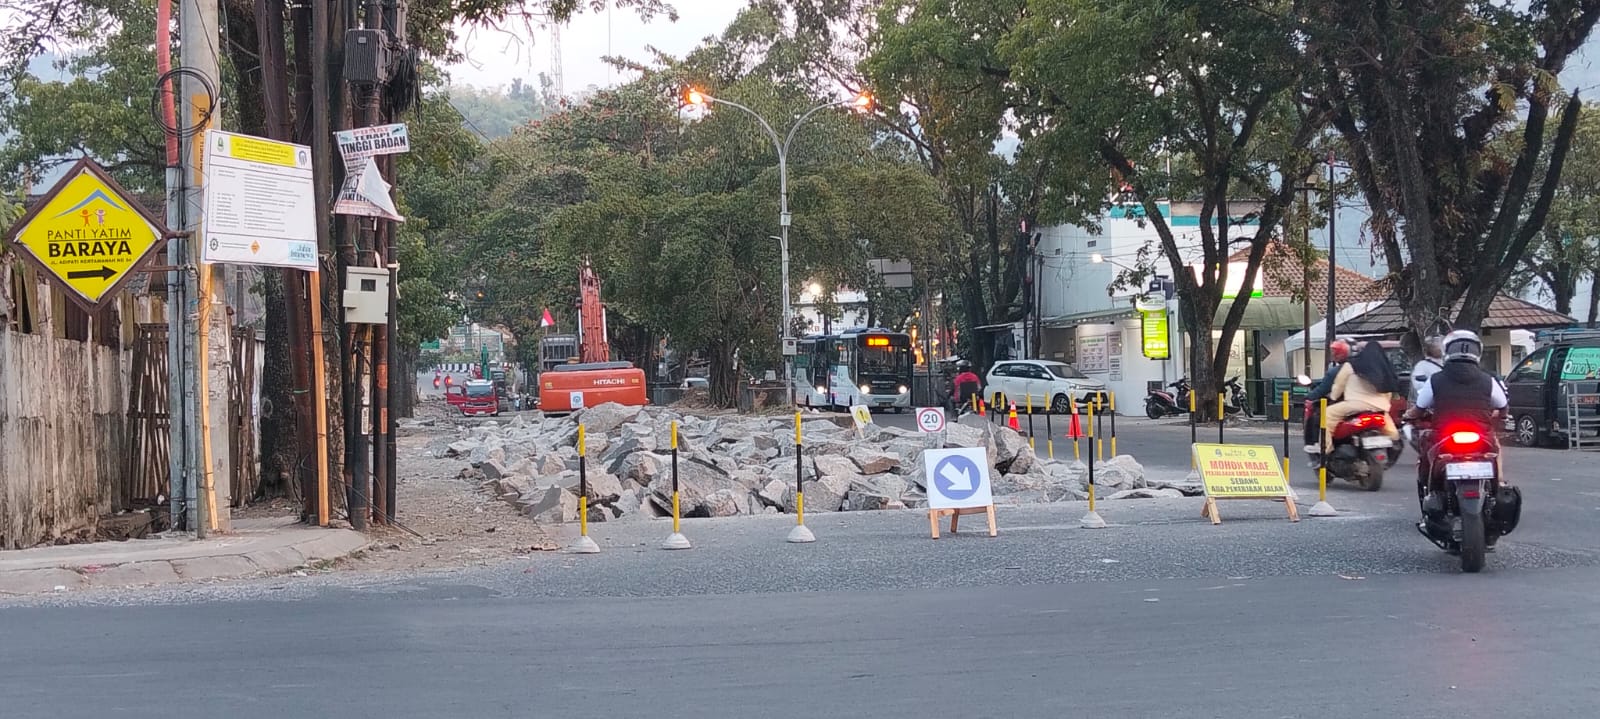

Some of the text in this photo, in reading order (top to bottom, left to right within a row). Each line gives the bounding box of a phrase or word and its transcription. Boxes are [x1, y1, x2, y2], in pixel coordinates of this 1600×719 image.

[354, 132, 390, 140] TERAPI
[341, 140, 372, 154] TINGGI
[374, 136, 406, 149] BADAN
[47, 227, 131, 239] PANTI YATIM
[48, 240, 132, 257] BARAYA
[923, 413, 938, 423] 20
[1209, 460, 1269, 470] MOHON MAAF
